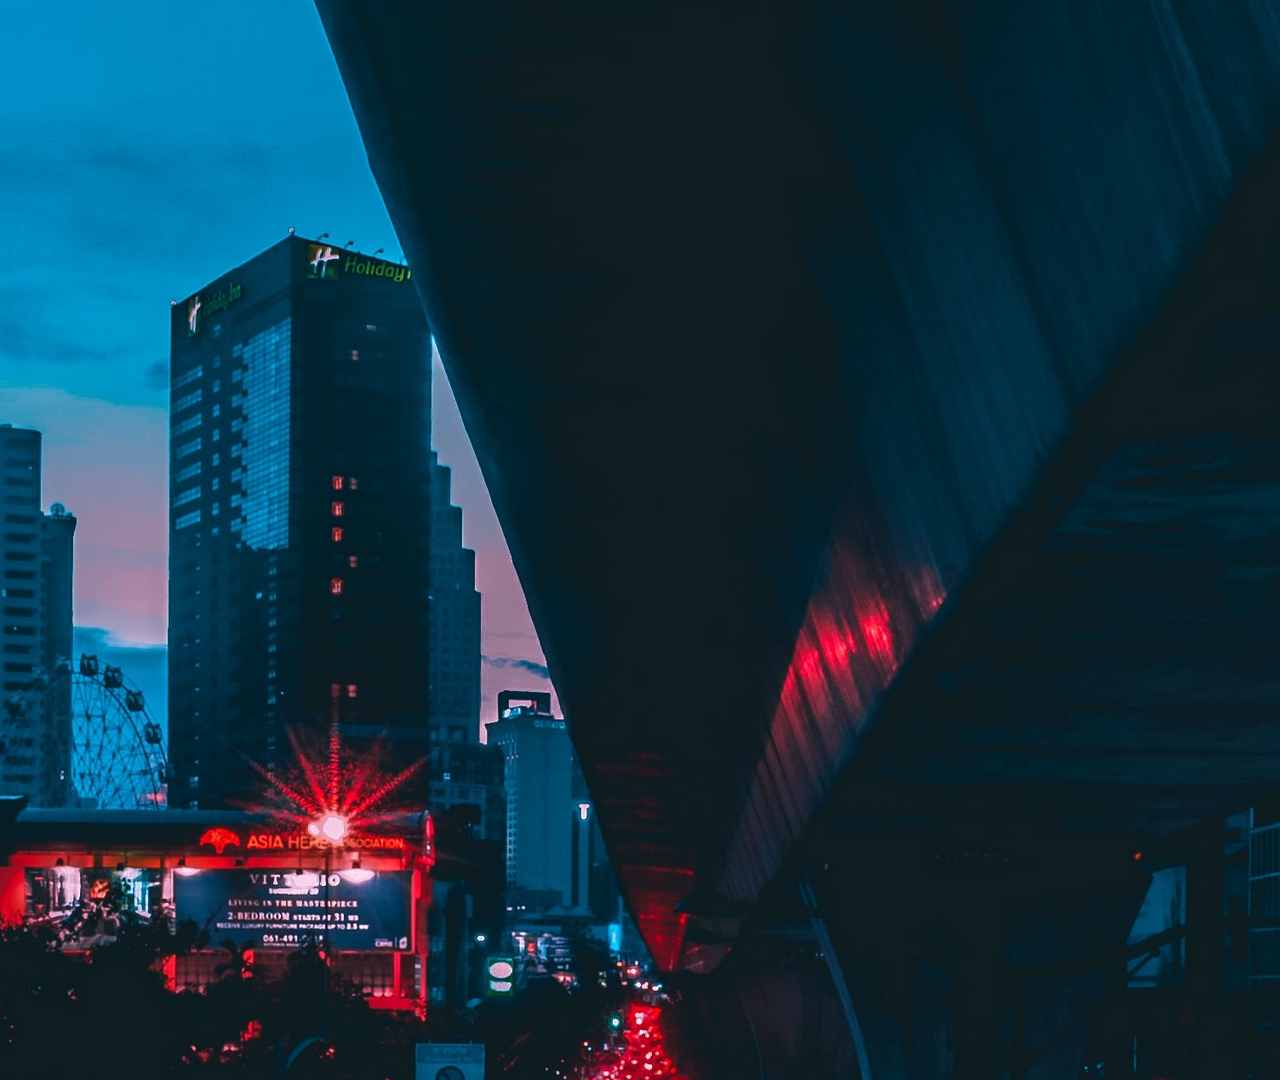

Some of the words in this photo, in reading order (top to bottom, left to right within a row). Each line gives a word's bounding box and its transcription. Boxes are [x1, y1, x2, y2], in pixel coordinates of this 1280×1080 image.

[345, 256, 405, 282] Holiday
[247, 835, 284, 849] ASIA
[332, 837, 404, 849] SSOCIATION
[250, 874, 341, 887] VITTIO
[227, 912, 290, 921] 2-BEDROOM
